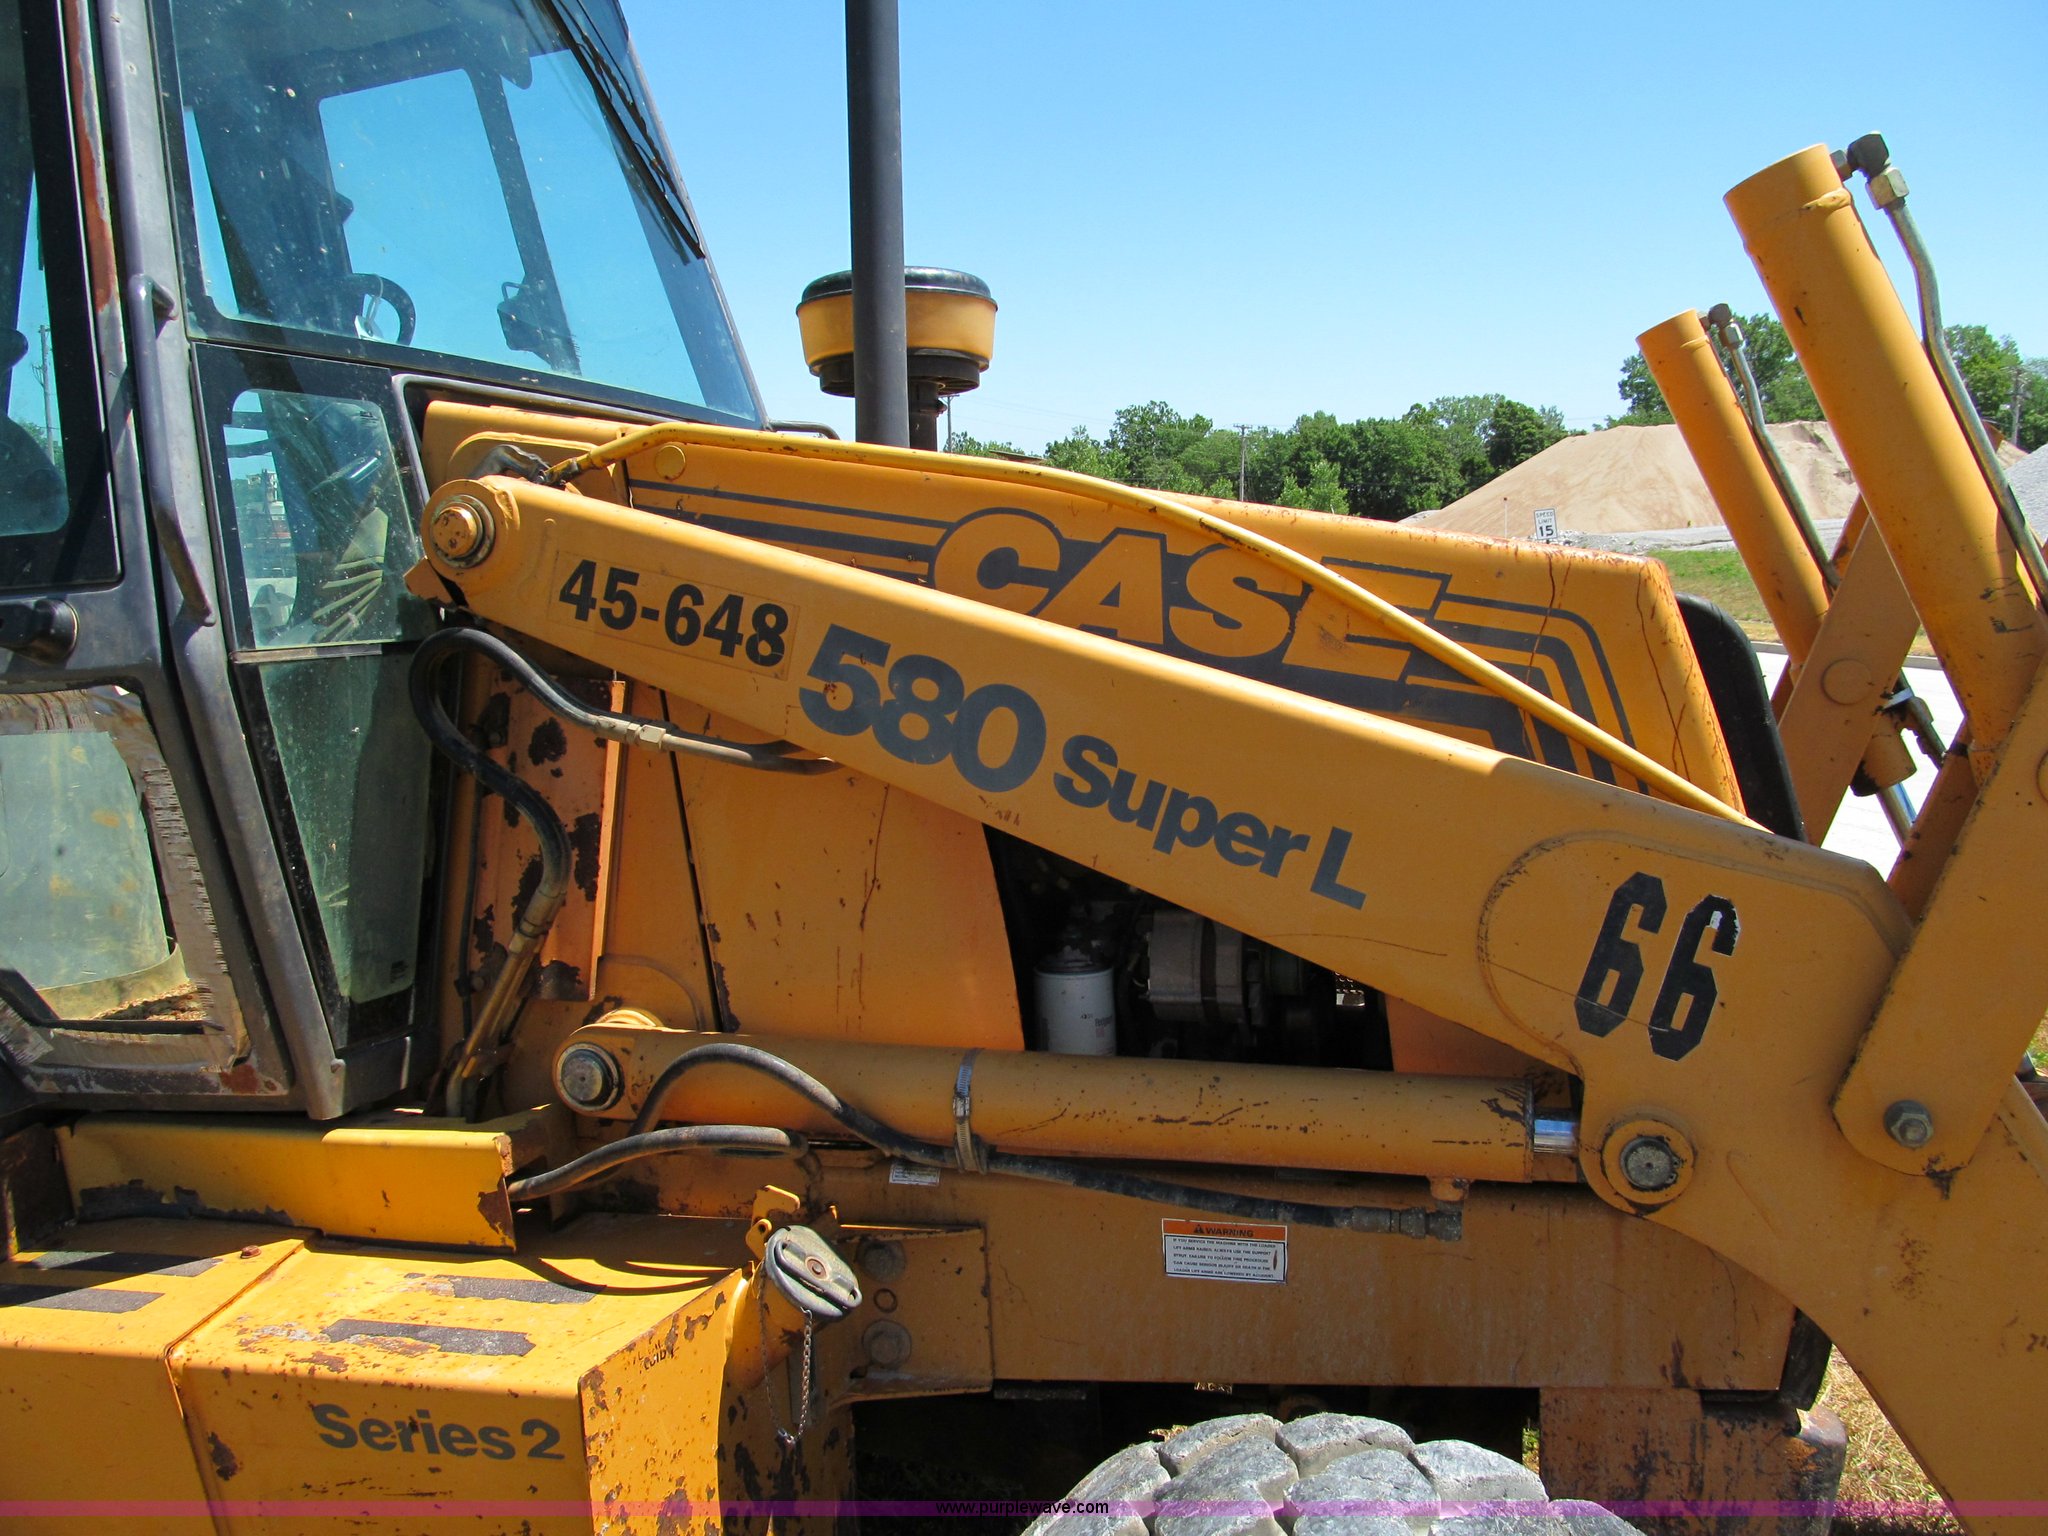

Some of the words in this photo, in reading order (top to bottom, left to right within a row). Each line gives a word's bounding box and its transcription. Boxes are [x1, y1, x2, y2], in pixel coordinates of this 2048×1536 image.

[1539, 525, 1554, 537] 15
[559, 559, 789, 667] 45-648
[933, 509, 1446, 683] CASE
[800, 623, 1047, 793] 580
[1053, 734, 1310, 879] Super
[1310, 826, 1366, 911] L
[1574, 871, 1741, 1062] 66
[1205, 1227, 1254, 1238] WARNING
[310, 1403, 516, 1461] Series
[521, 1418, 566, 1461] 2
